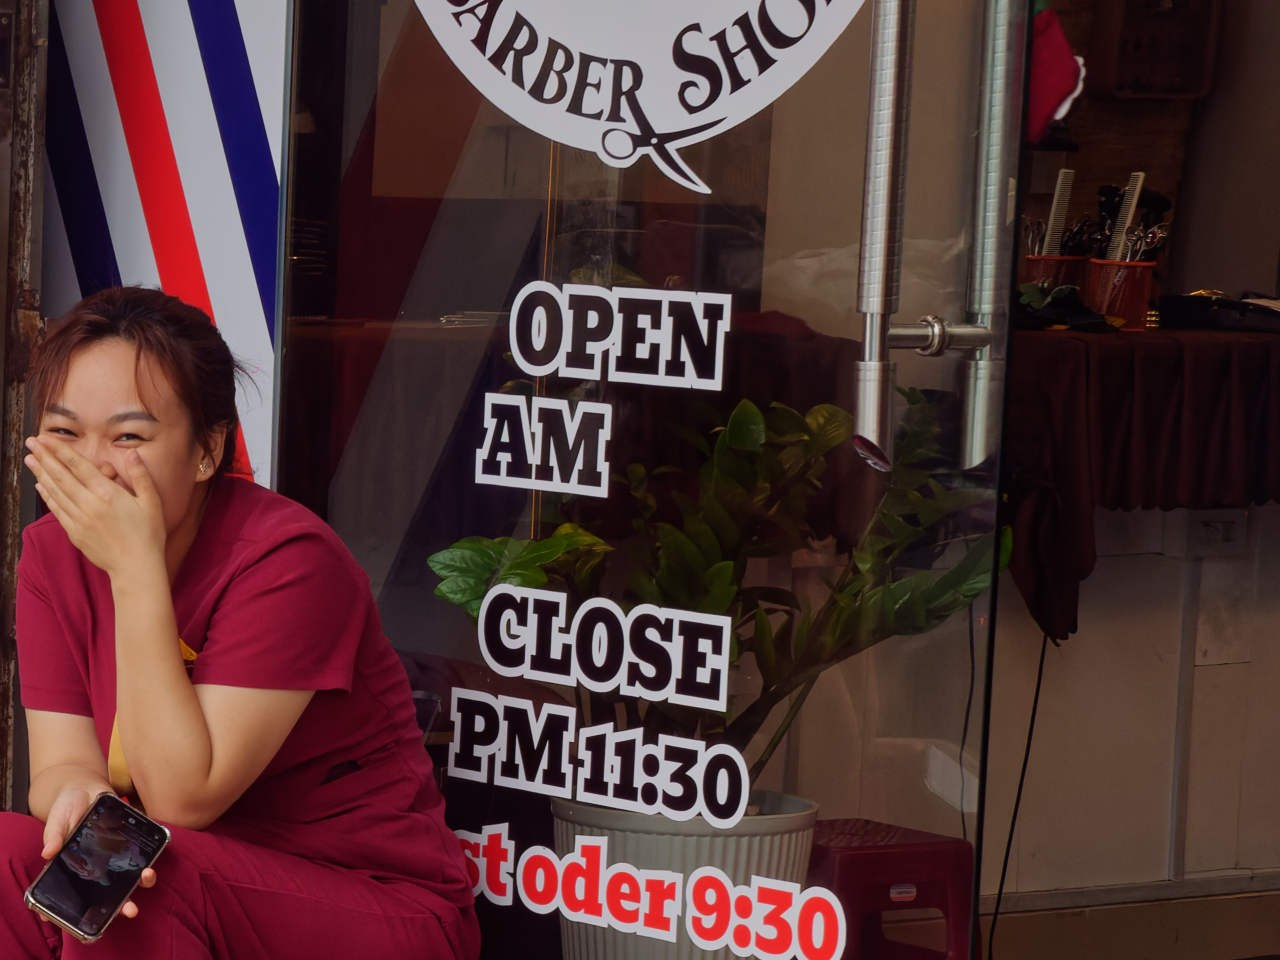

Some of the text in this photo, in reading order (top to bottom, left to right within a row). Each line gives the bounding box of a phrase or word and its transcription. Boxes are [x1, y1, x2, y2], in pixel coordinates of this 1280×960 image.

[447, 0, 832, 132] ARBER SHO
[517, 290, 724, 380] OPEN
[482, 403, 605, 487] AM
[484, 592, 724, 701] CLOSE
[453, 697, 742, 820] PM 11:30
[459, 832, 509, 896] st
[522, 845, 676, 932] oder
